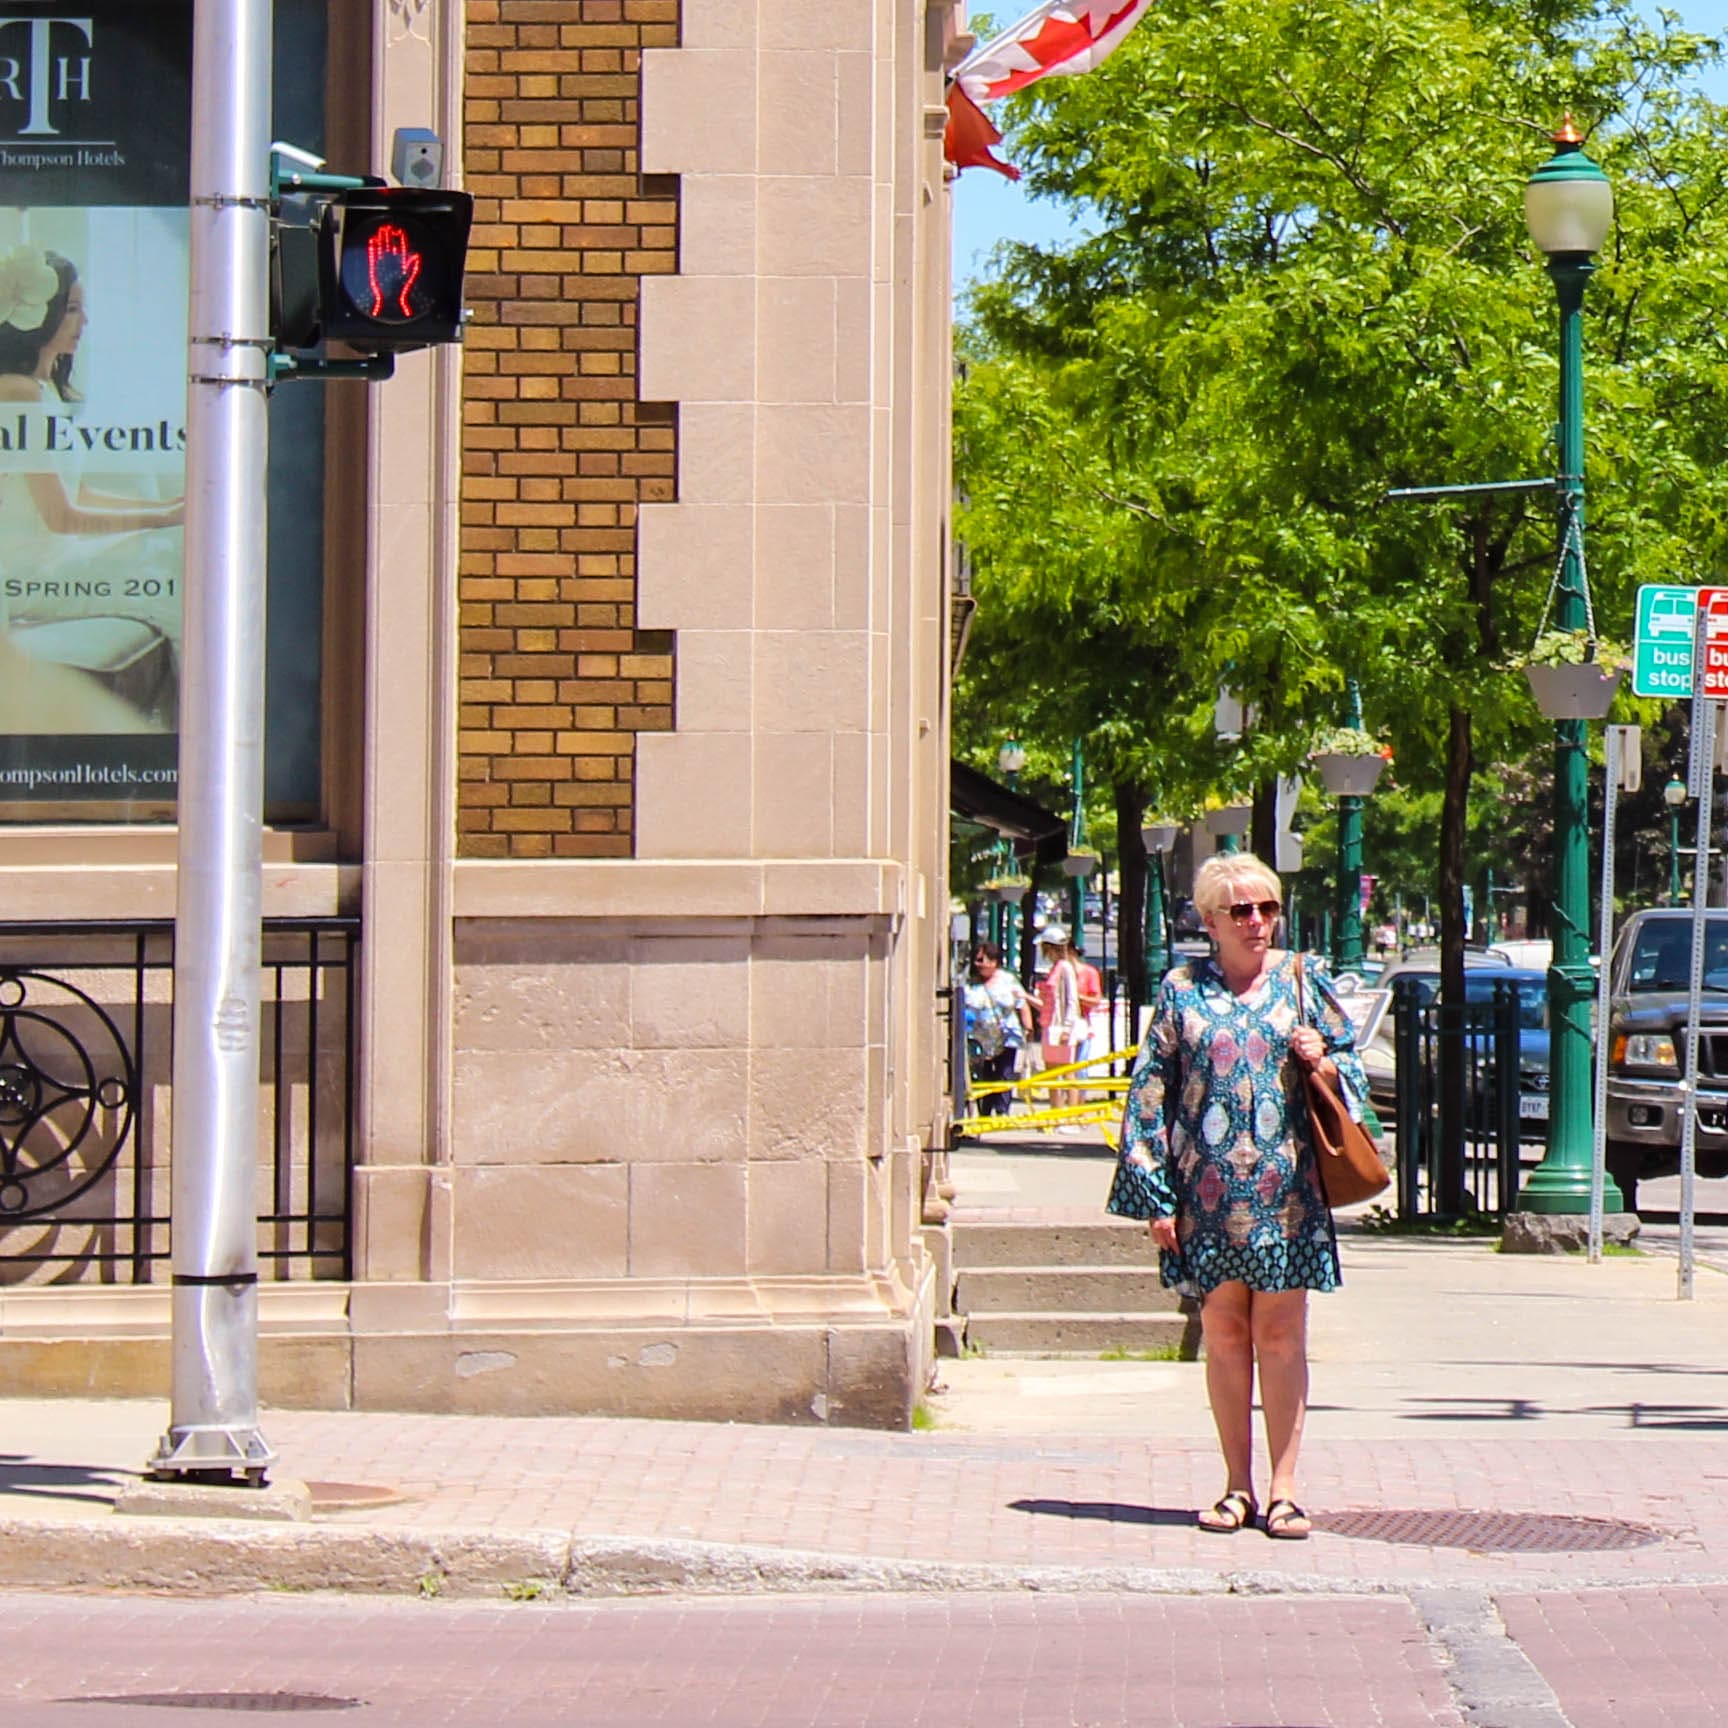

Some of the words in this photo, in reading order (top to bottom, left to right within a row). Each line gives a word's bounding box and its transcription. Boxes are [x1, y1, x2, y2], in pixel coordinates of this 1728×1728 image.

[0, 151, 73, 170] hompson
[77, 150, 126, 166] Hotels
[46, 415, 187, 452] Events
[5, 579, 112, 598] SPRING
[123, 579, 176, 598] 201
[1653, 647, 1691, 666] bus
[1648, 669, 1692, 691] stop
